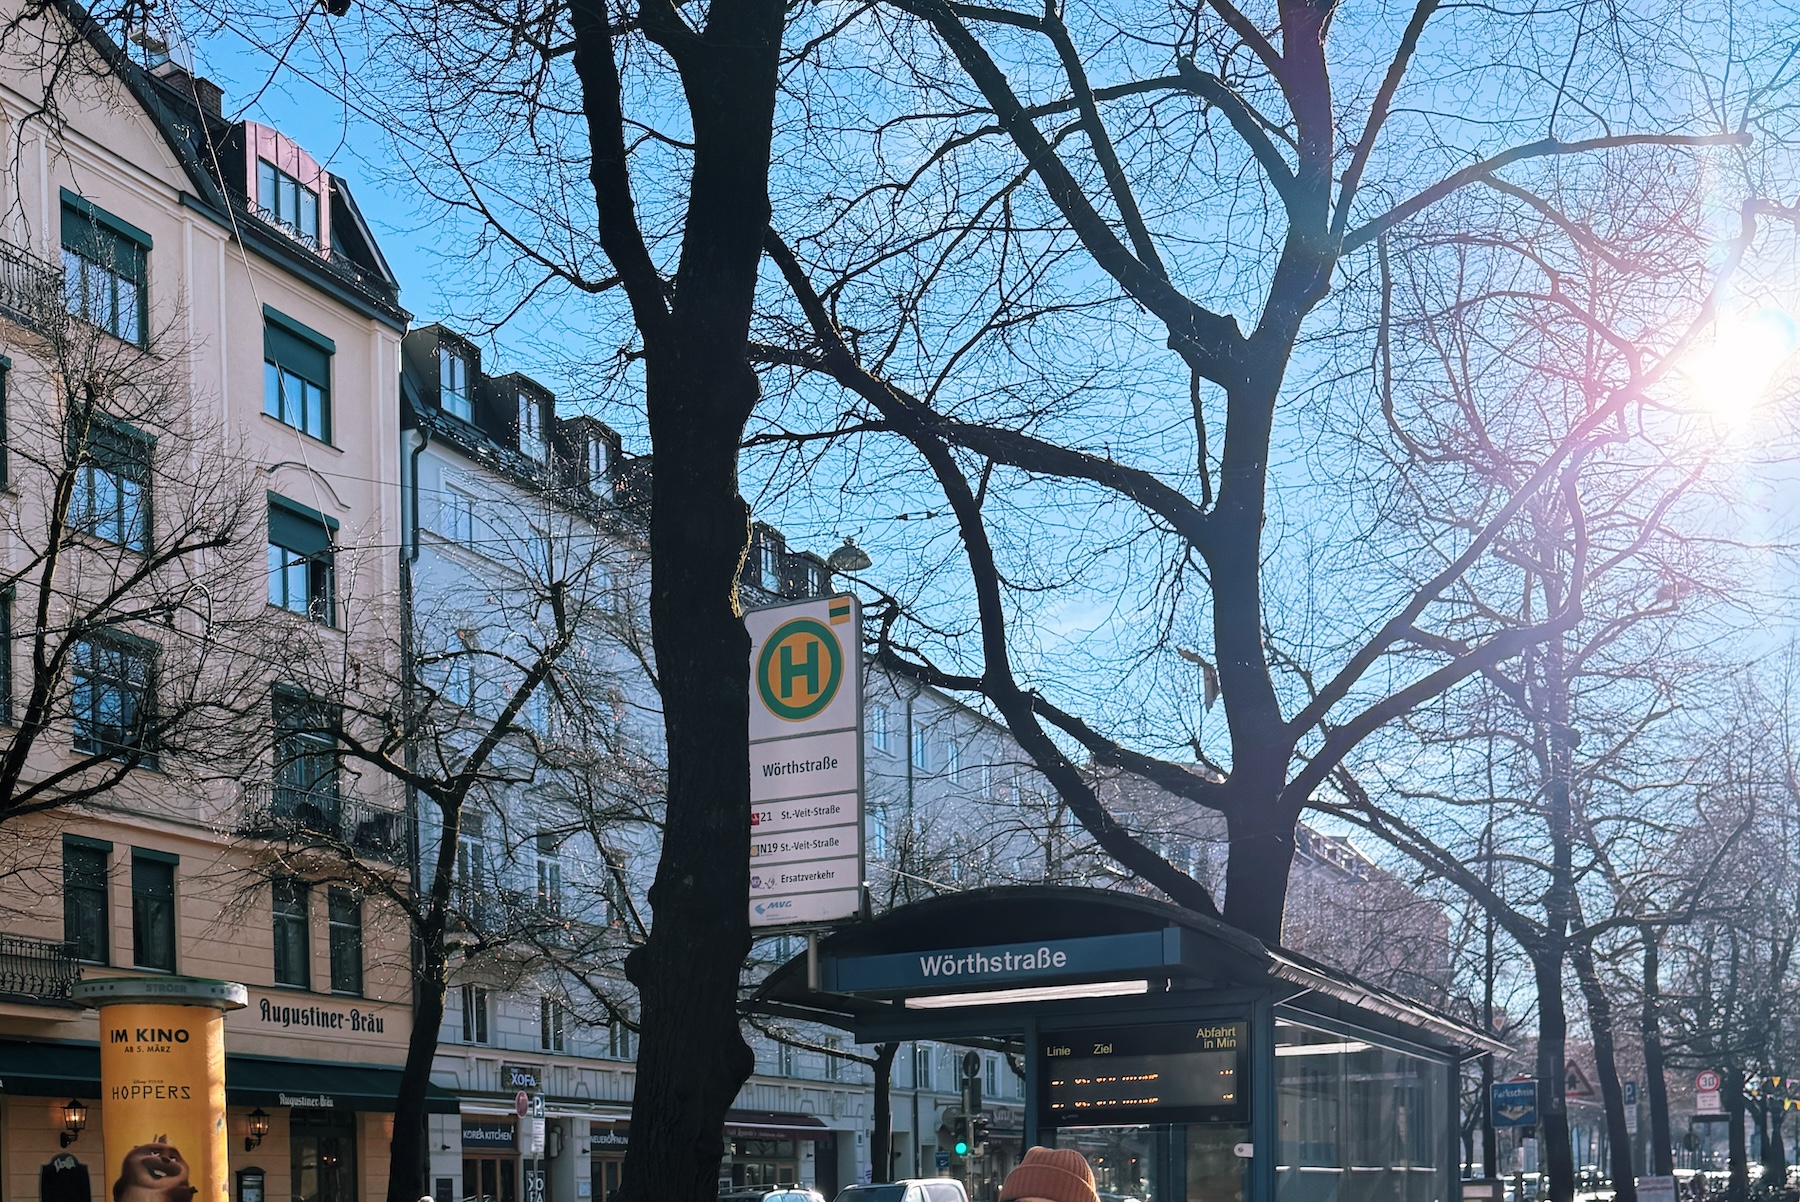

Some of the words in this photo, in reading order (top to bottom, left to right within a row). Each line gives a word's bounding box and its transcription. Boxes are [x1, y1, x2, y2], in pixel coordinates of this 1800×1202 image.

[780, 641, 819, 699] H
[762, 756, 838, 777] Wörthstraße
[760, 811, 773, 822] 21
[781, 804, 841, 820] St.-Veit-Straße
[760, 842, 778, 854] N19
[780, 837, 840, 853] St.-Veit-Straße
[781, 870, 835, 884] Ersatzverkehr
[766, 900, 792, 909] MVG
[919, 947, 1067, 977] Wörthstraße
[260, 998, 384, 1033] Augustiner-Bräu
[110, 1029, 129, 1043] IM
[136, 1028, 190, 1043] KINO
[1196, 1027, 1236, 1038] Abfahrt
[147, 1044, 171, 1053] MÄRZ
[1093, 1043, 1113, 1055] Ziel
[1203, 1039, 1214, 1049] in
[1216, 1038, 1236, 1048] Min
[1046, 1046, 1071, 1057] Linie
[1701, 1076, 1715, 1087] 30
[112, 1086, 191, 1100] HOPPERS
[1493, 1088, 1534, 1098] Parkschein
[463, 1130, 484, 1140] KOREA
[485, 1131, 512, 1141] KITCHEN
